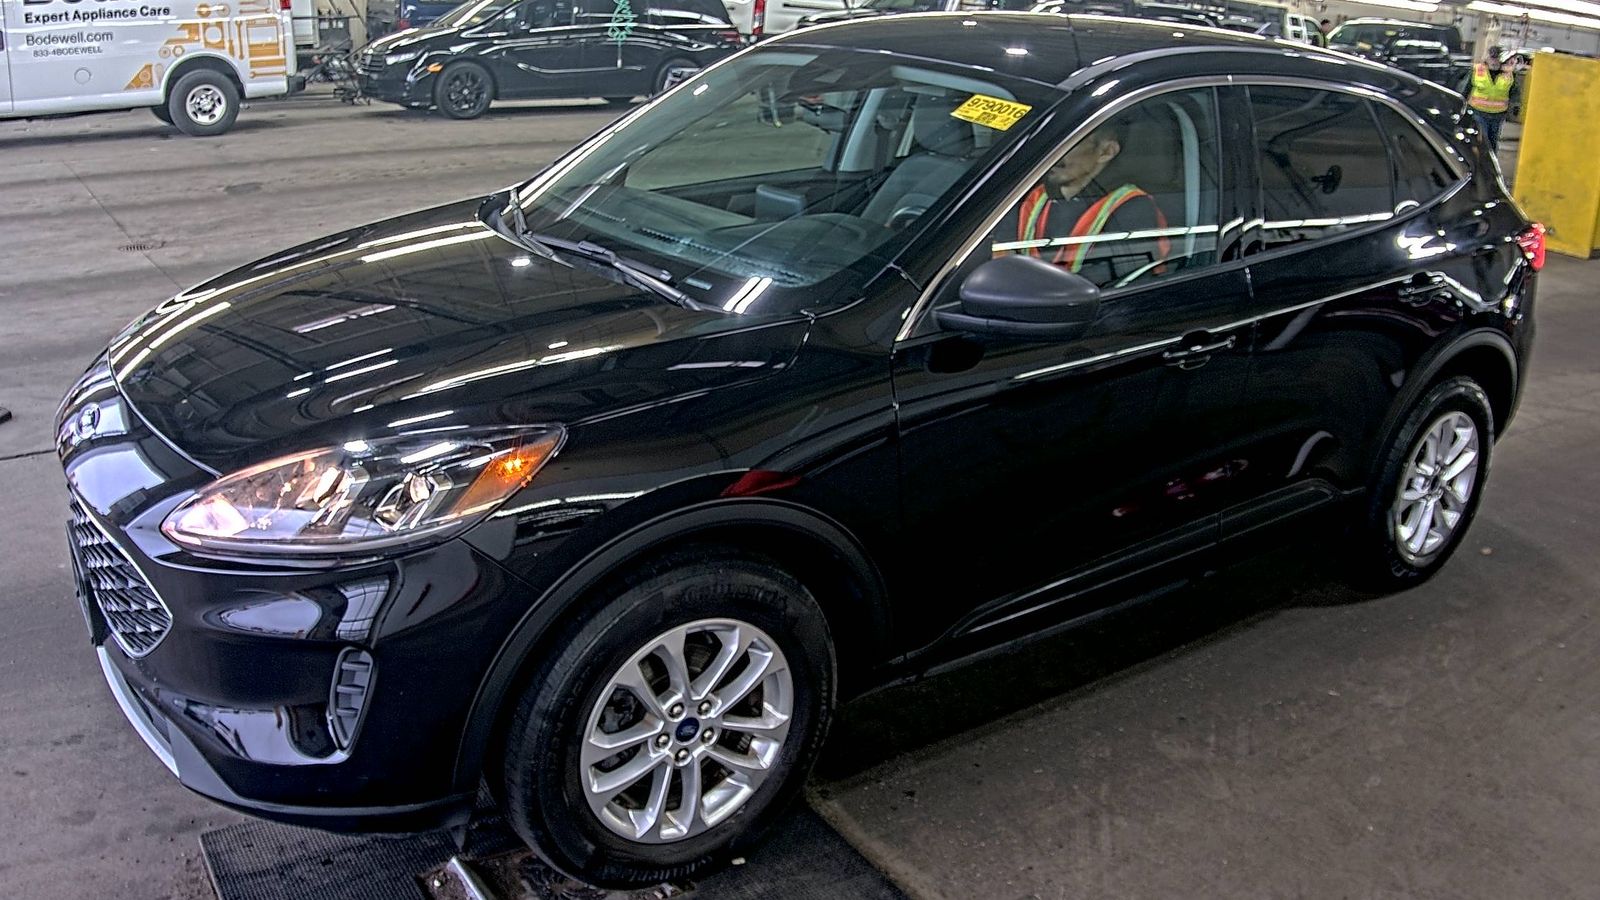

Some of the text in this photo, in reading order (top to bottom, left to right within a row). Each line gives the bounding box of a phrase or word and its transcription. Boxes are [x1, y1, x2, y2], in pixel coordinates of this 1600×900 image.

[24, 5, 171, 24] Expert Appliance Care
[25, 31, 114, 47] Bodewell.com
[33, 46, 103, 58] 833-4BODEWELL
[967, 98, 1026, 118] 9790016
